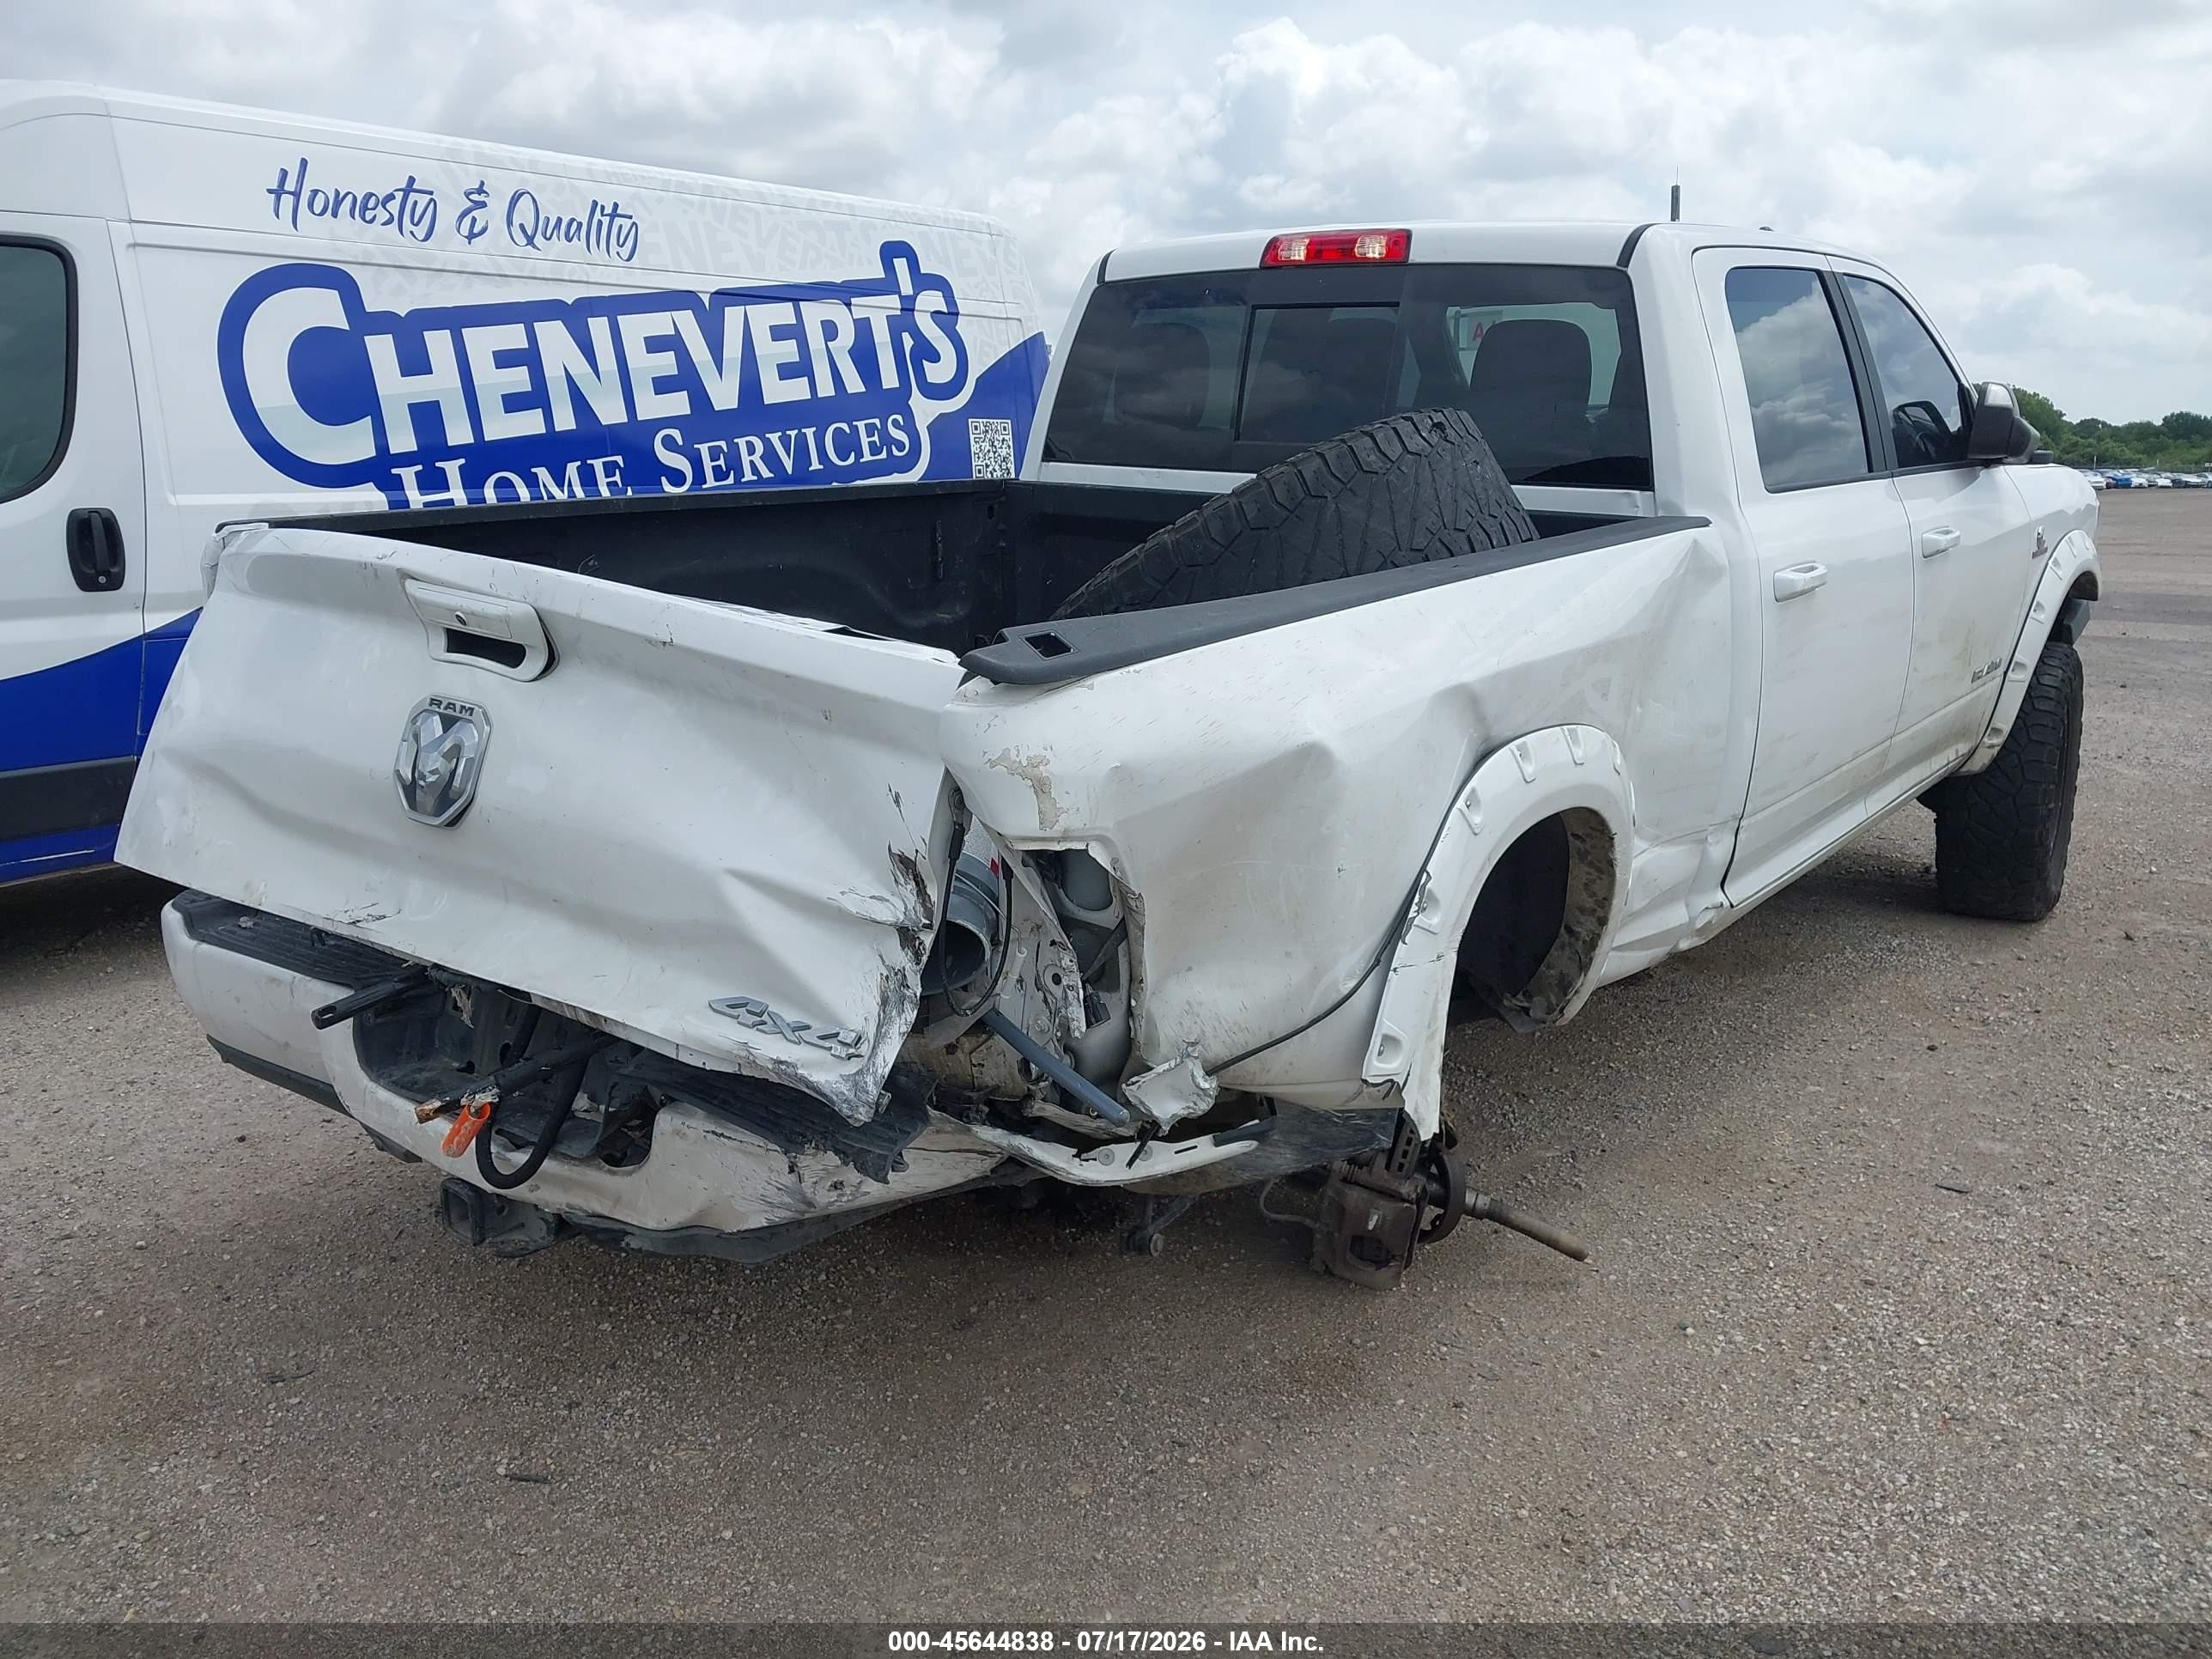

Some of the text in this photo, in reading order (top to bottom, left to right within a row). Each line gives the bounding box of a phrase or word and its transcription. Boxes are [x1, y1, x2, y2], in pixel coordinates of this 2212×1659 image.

[266, 157, 640, 262] Honesty & Quality
[242, 258, 957, 465] CHENEVERT'S
[653, 414, 910, 494] SERVICES
[428, 697, 475, 717] RAM
